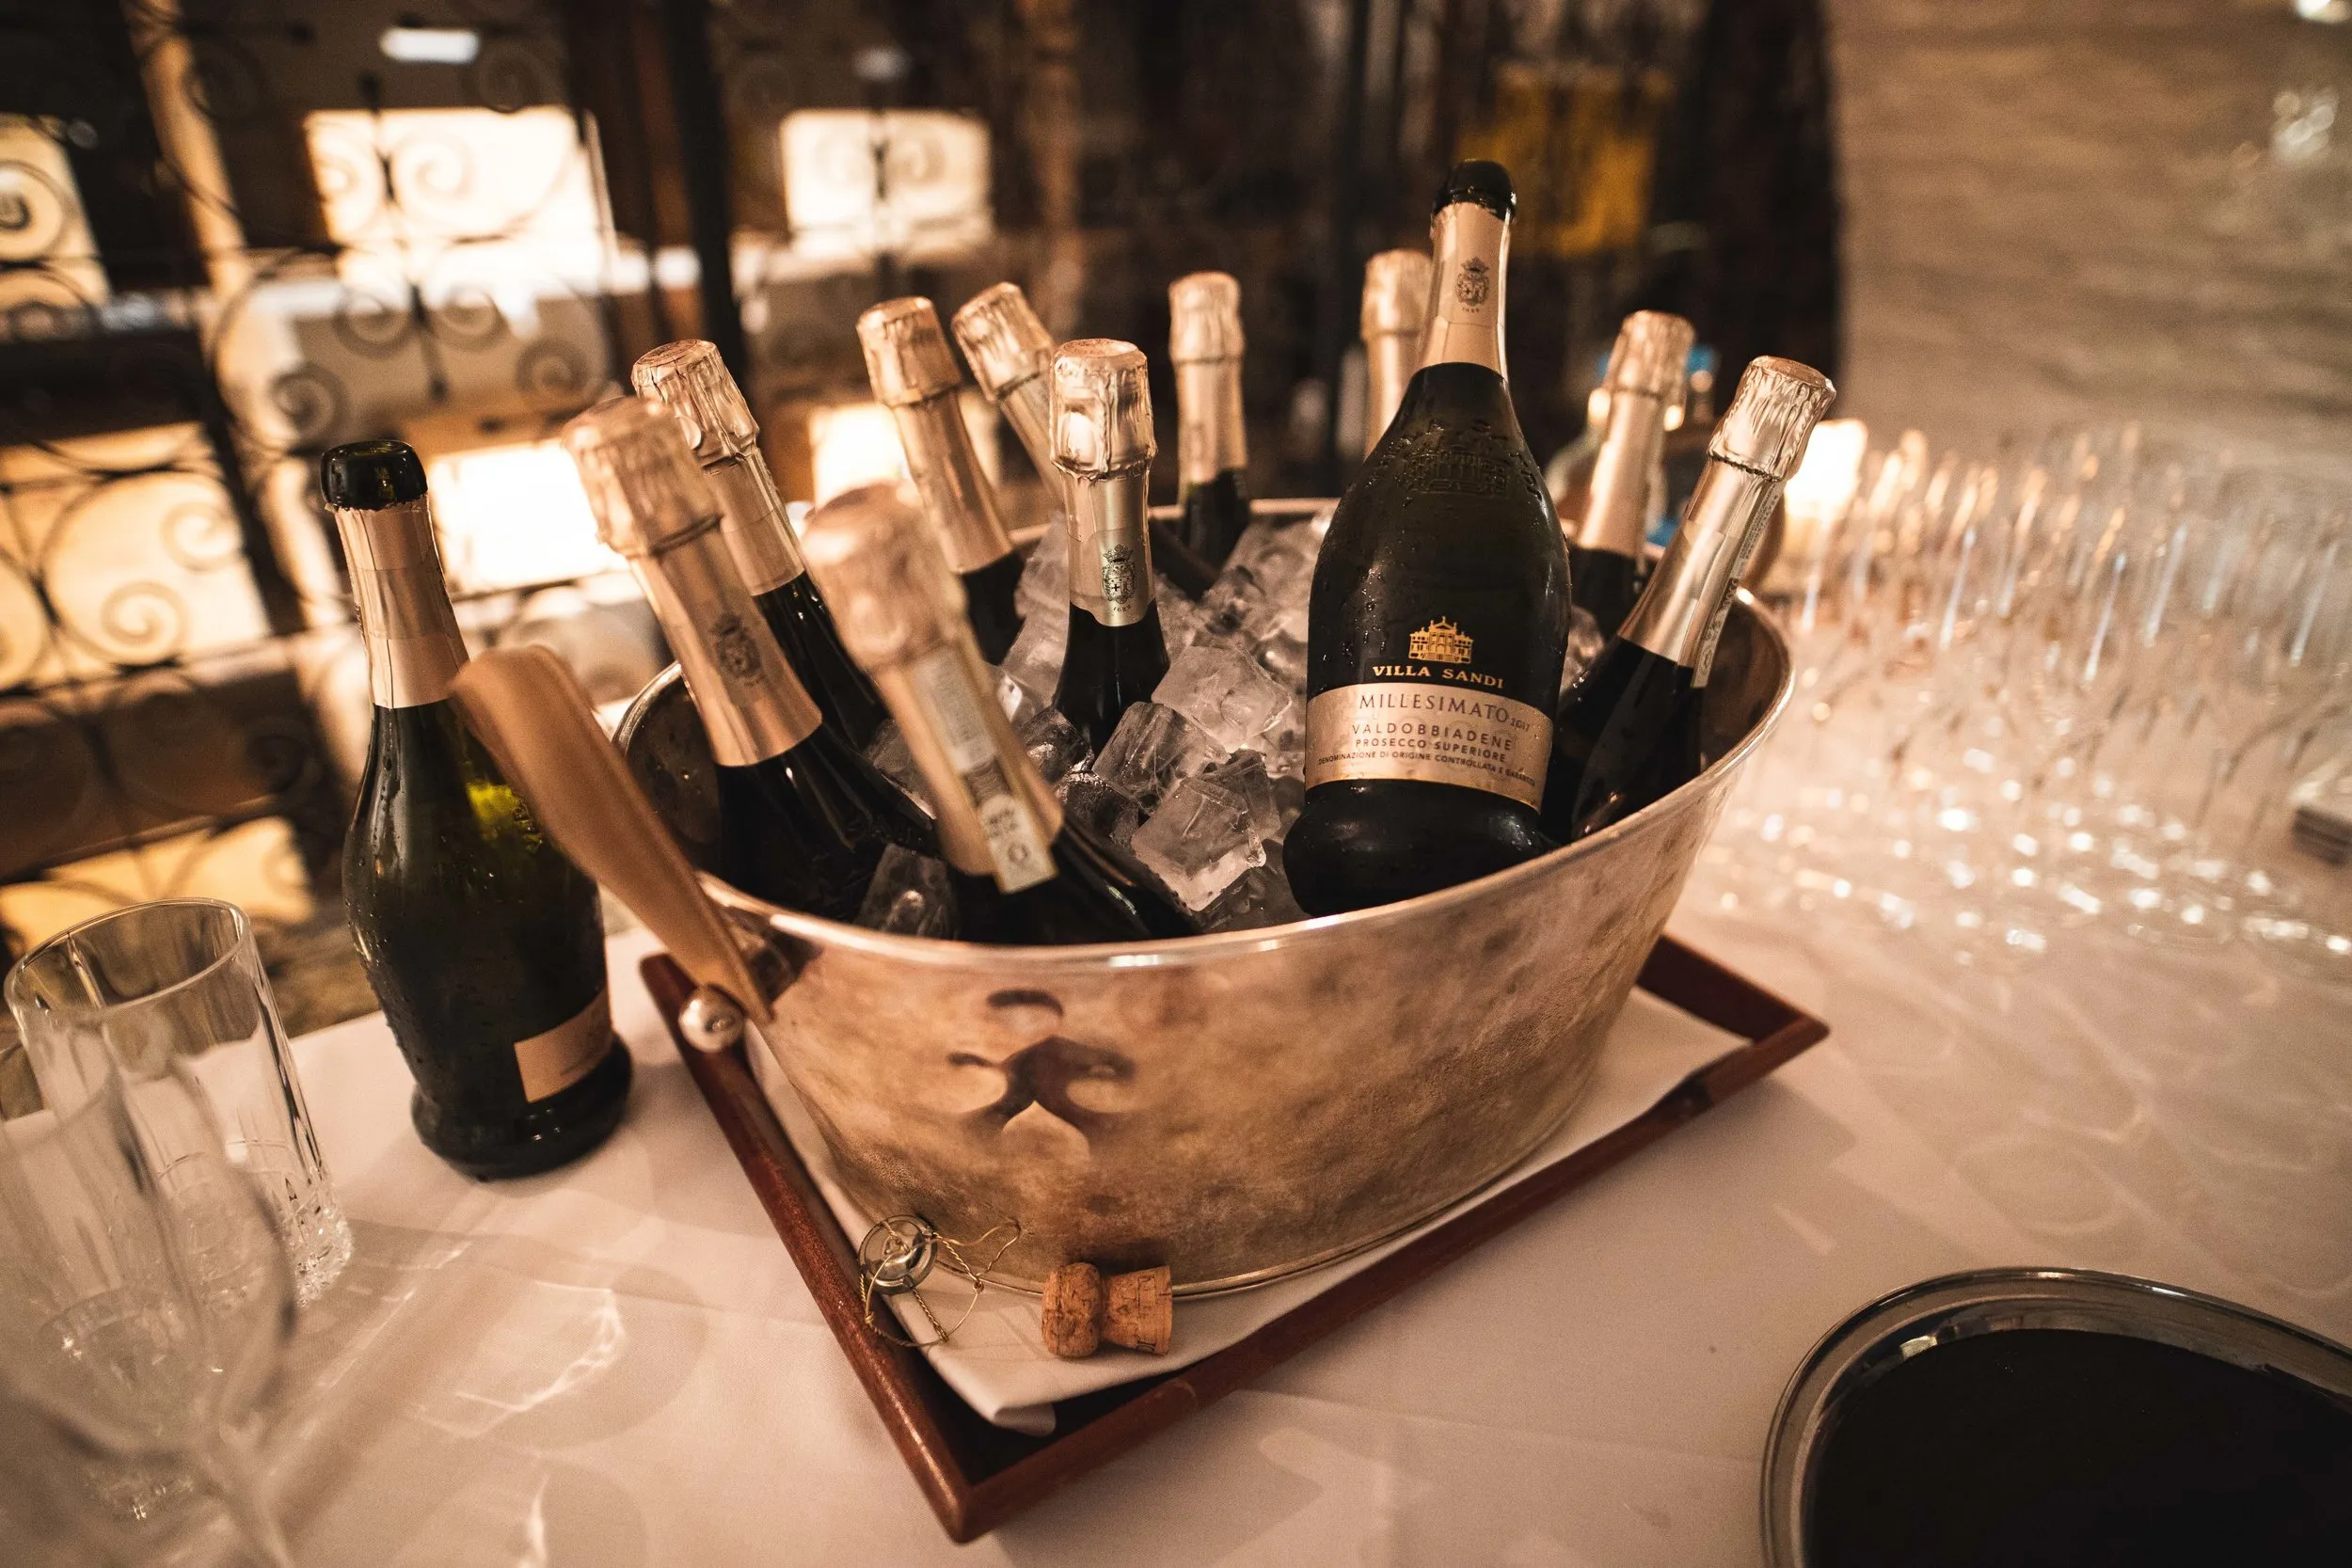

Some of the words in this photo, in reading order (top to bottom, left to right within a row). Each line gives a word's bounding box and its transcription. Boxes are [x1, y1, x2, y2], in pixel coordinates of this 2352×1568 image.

[1373, 665, 1431, 676] VILLA
[1442, 668, 1504, 689] SANDI
[1359, 693, 1510, 722] MILLESIMATO
[1352, 723, 1512, 751] VALDOBBIADENE
[1318, 752, 1375, 765] DENOMINAZIONE
[1392, 752, 1431, 761] ORIGINE
[1435, 754, 1496, 772] CONTROLLATA
[1356, 738, 1426, 749] PROSECCO
[1434, 741, 1506, 763] SUPERIORE
